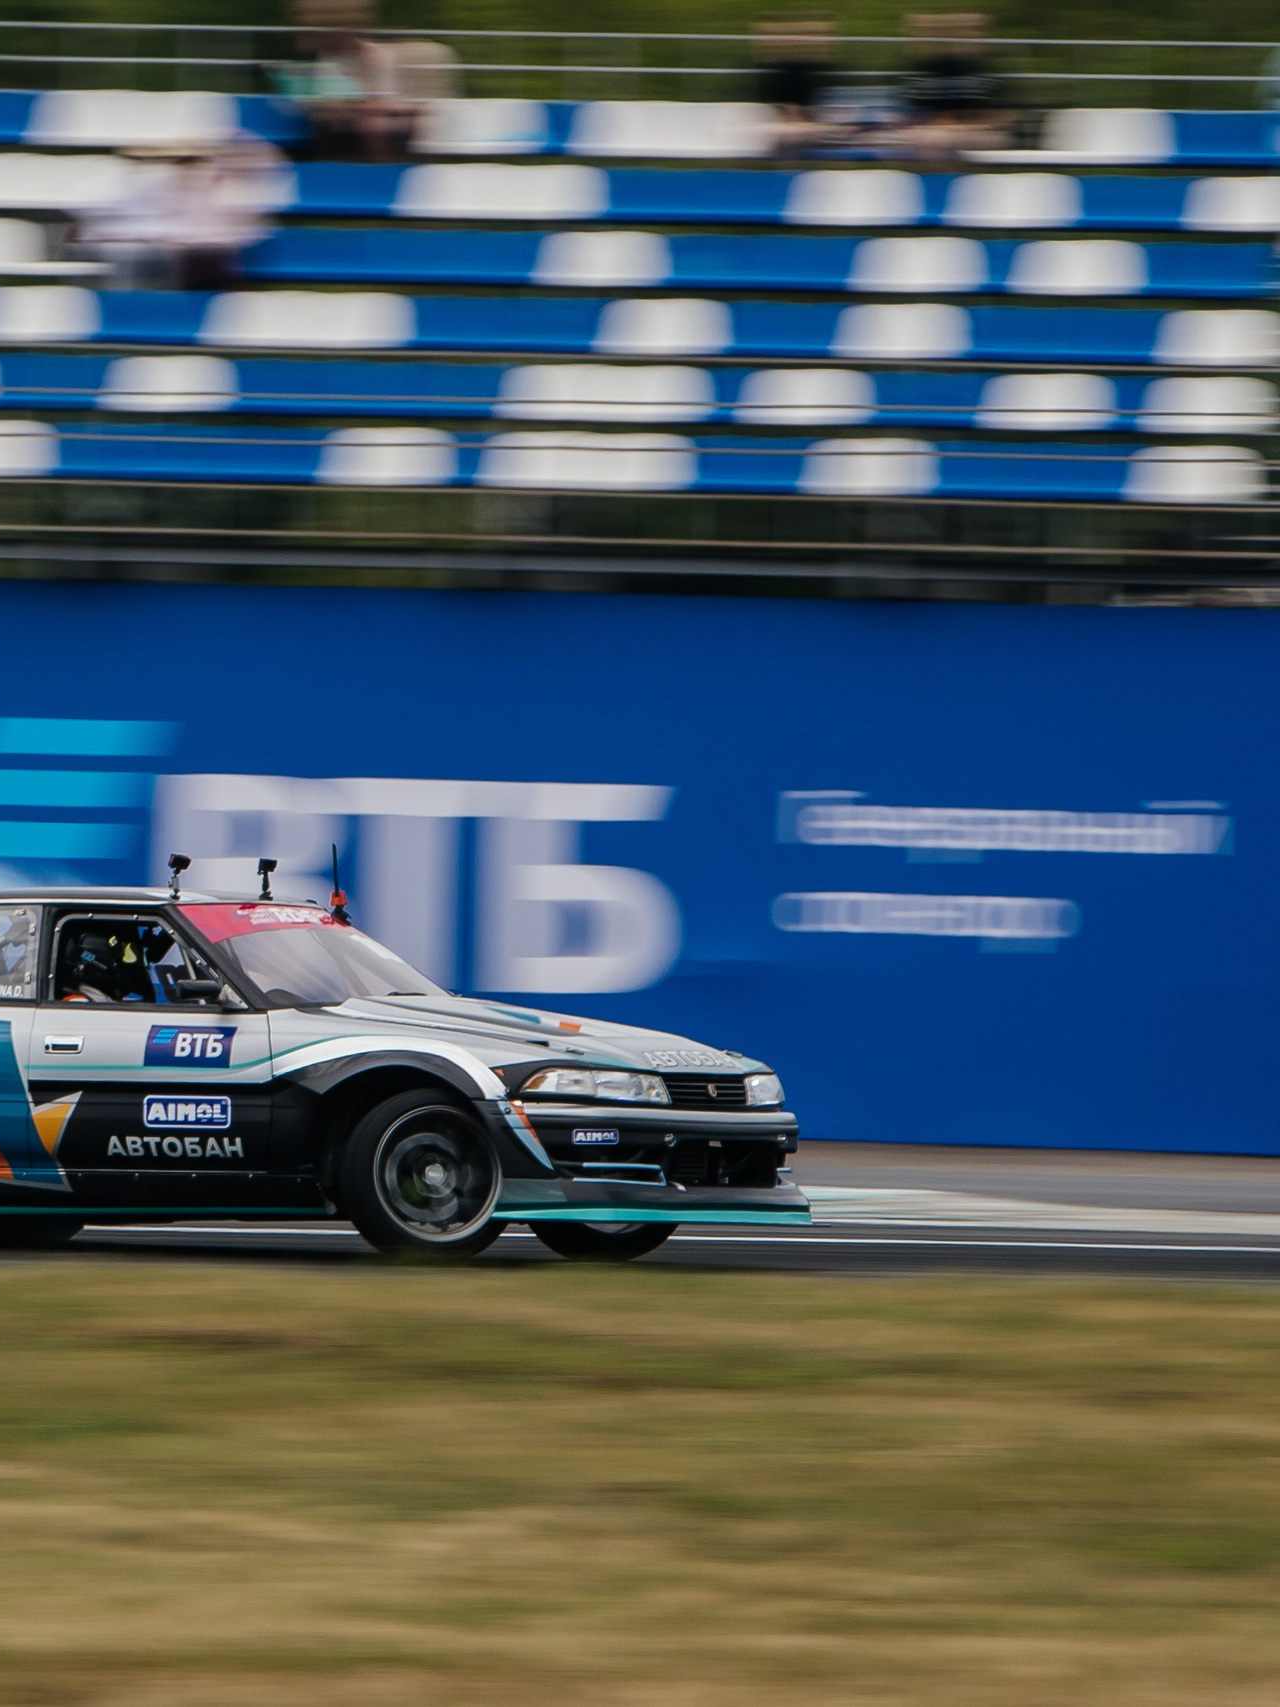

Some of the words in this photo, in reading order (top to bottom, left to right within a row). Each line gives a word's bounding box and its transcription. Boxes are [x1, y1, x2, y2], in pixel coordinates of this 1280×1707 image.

[148, 773, 686, 993] ВТБ
[174, 1033, 225, 1058] ВТБ
[147, 1102, 227, 1122] AIMOL
[107, 1135, 245, 1158] АВТОБАН
[575, 1131, 618, 1142] AIMOL
